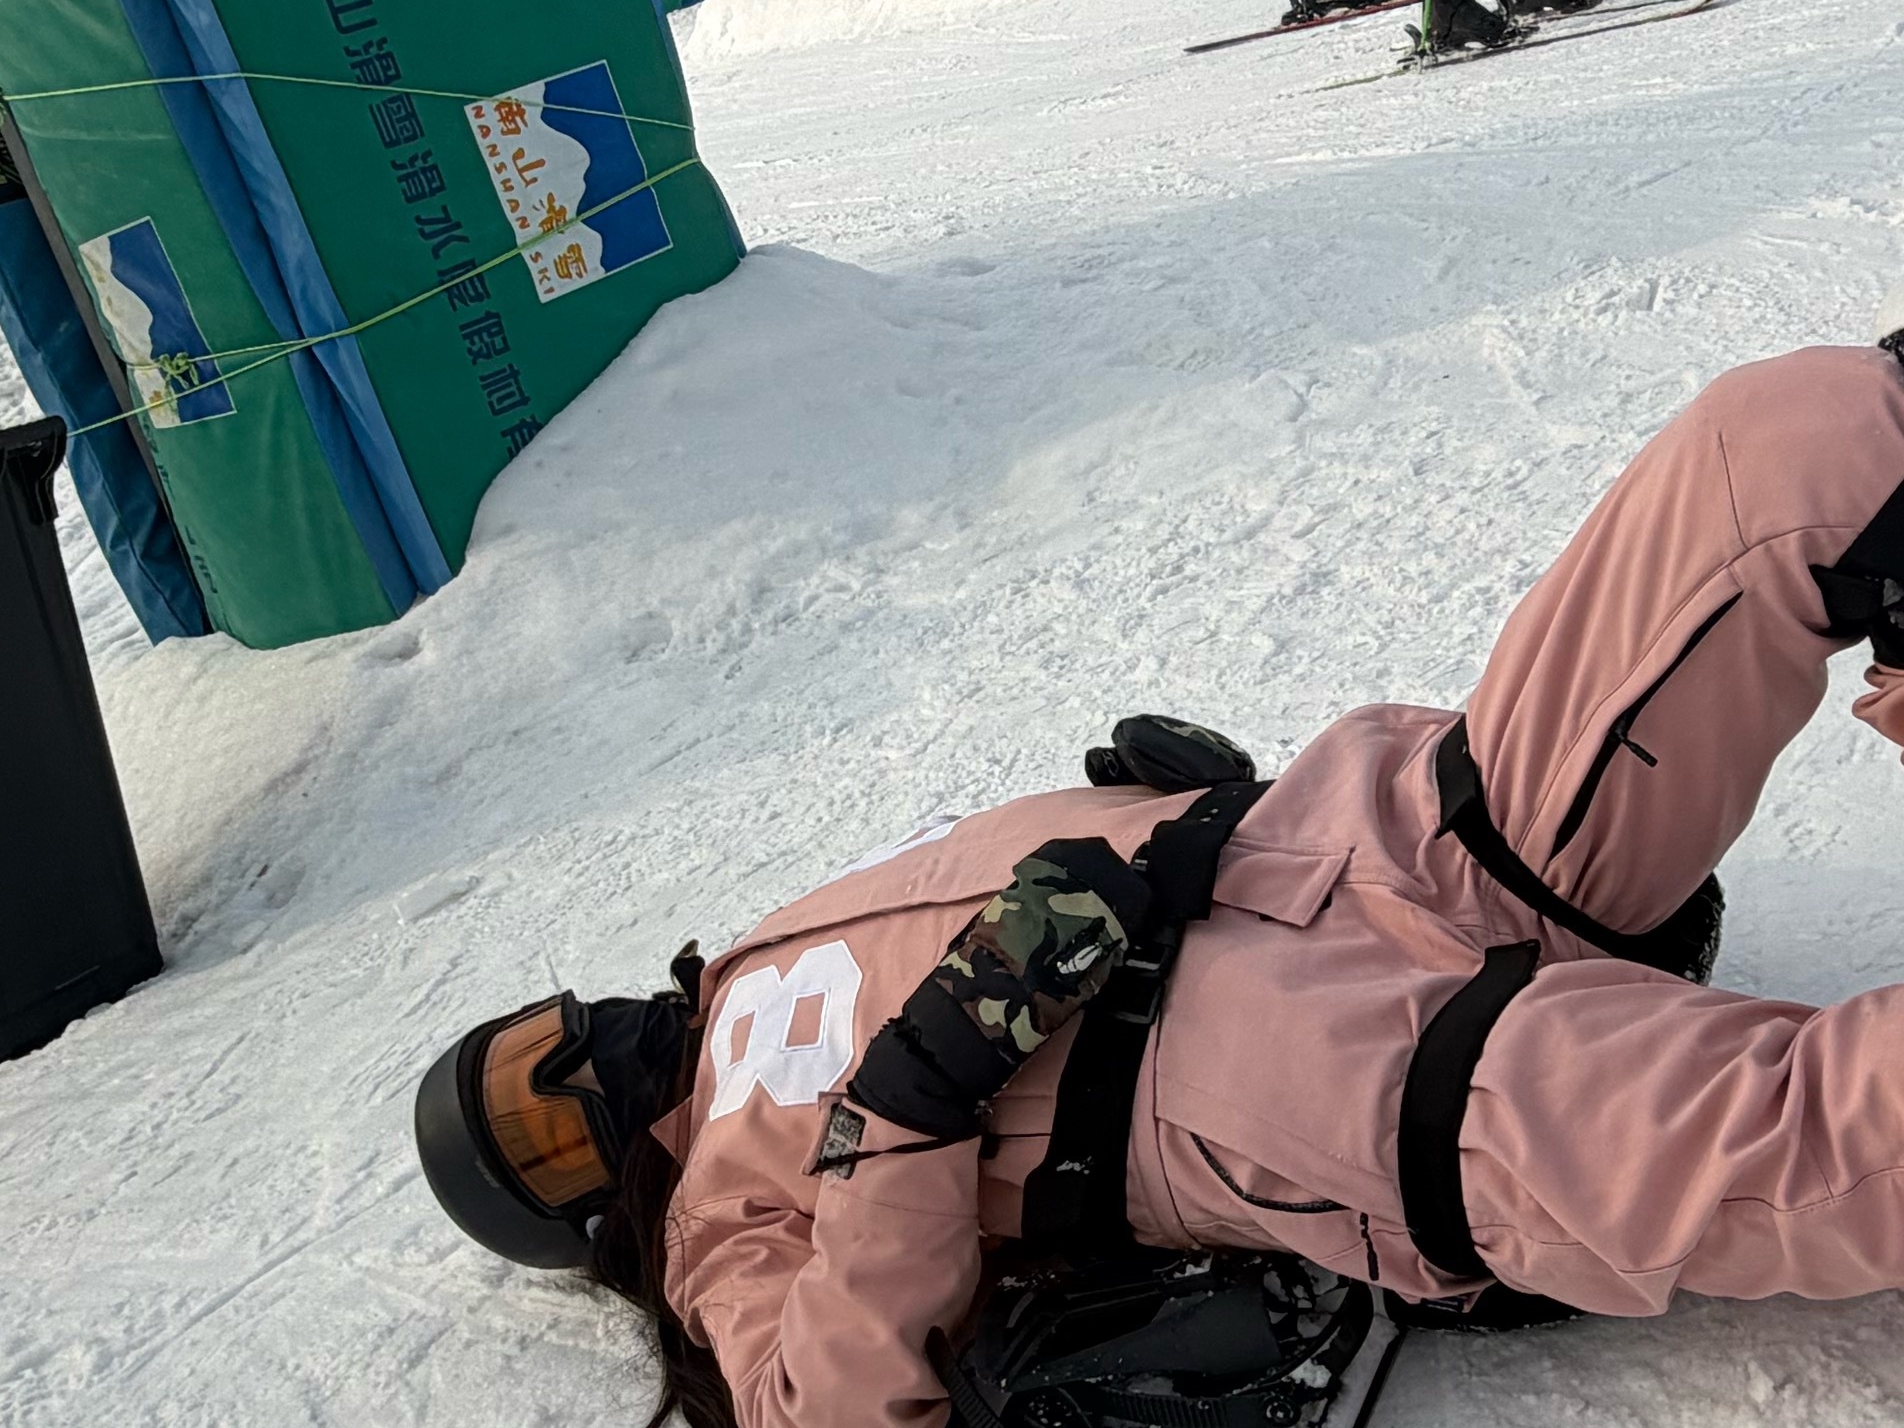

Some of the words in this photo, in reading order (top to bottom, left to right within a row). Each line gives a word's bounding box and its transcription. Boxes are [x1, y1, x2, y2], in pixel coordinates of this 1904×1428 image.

[470, 104, 531, 231] NANSHAN
[528, 250, 556, 295] SKI
[492, 95, 589, 280] 南山滑雪
